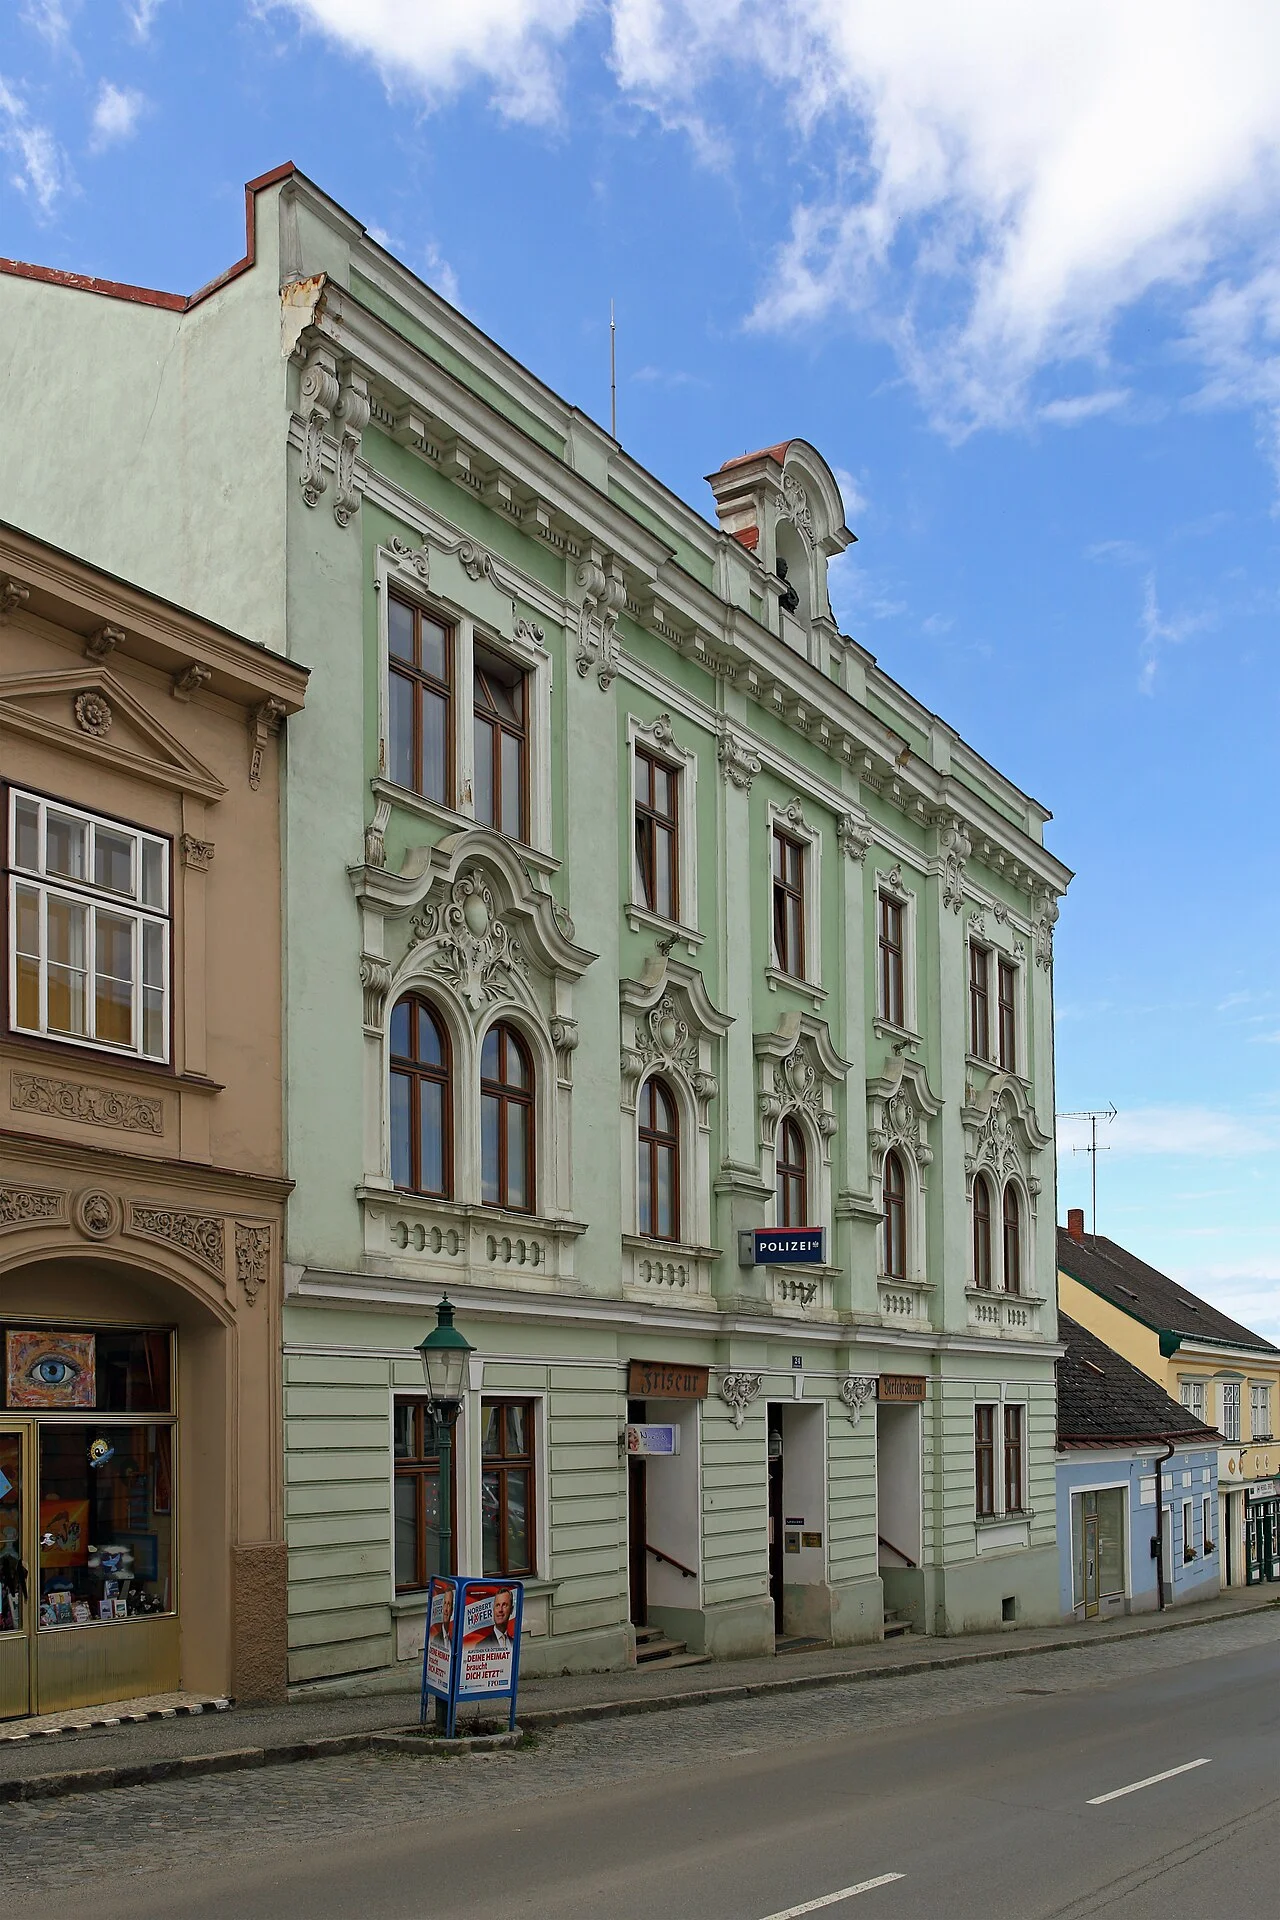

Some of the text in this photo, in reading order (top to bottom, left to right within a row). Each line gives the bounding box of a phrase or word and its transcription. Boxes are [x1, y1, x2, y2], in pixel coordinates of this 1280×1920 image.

[759, 1241, 811, 1252] POLIZEI
[467, 1601, 492, 1616] NORBERT
[486, 1652, 510, 1661] HEIMAT
[466, 1662, 487, 1671] braucht
[465, 1671, 481, 1680] DICH
